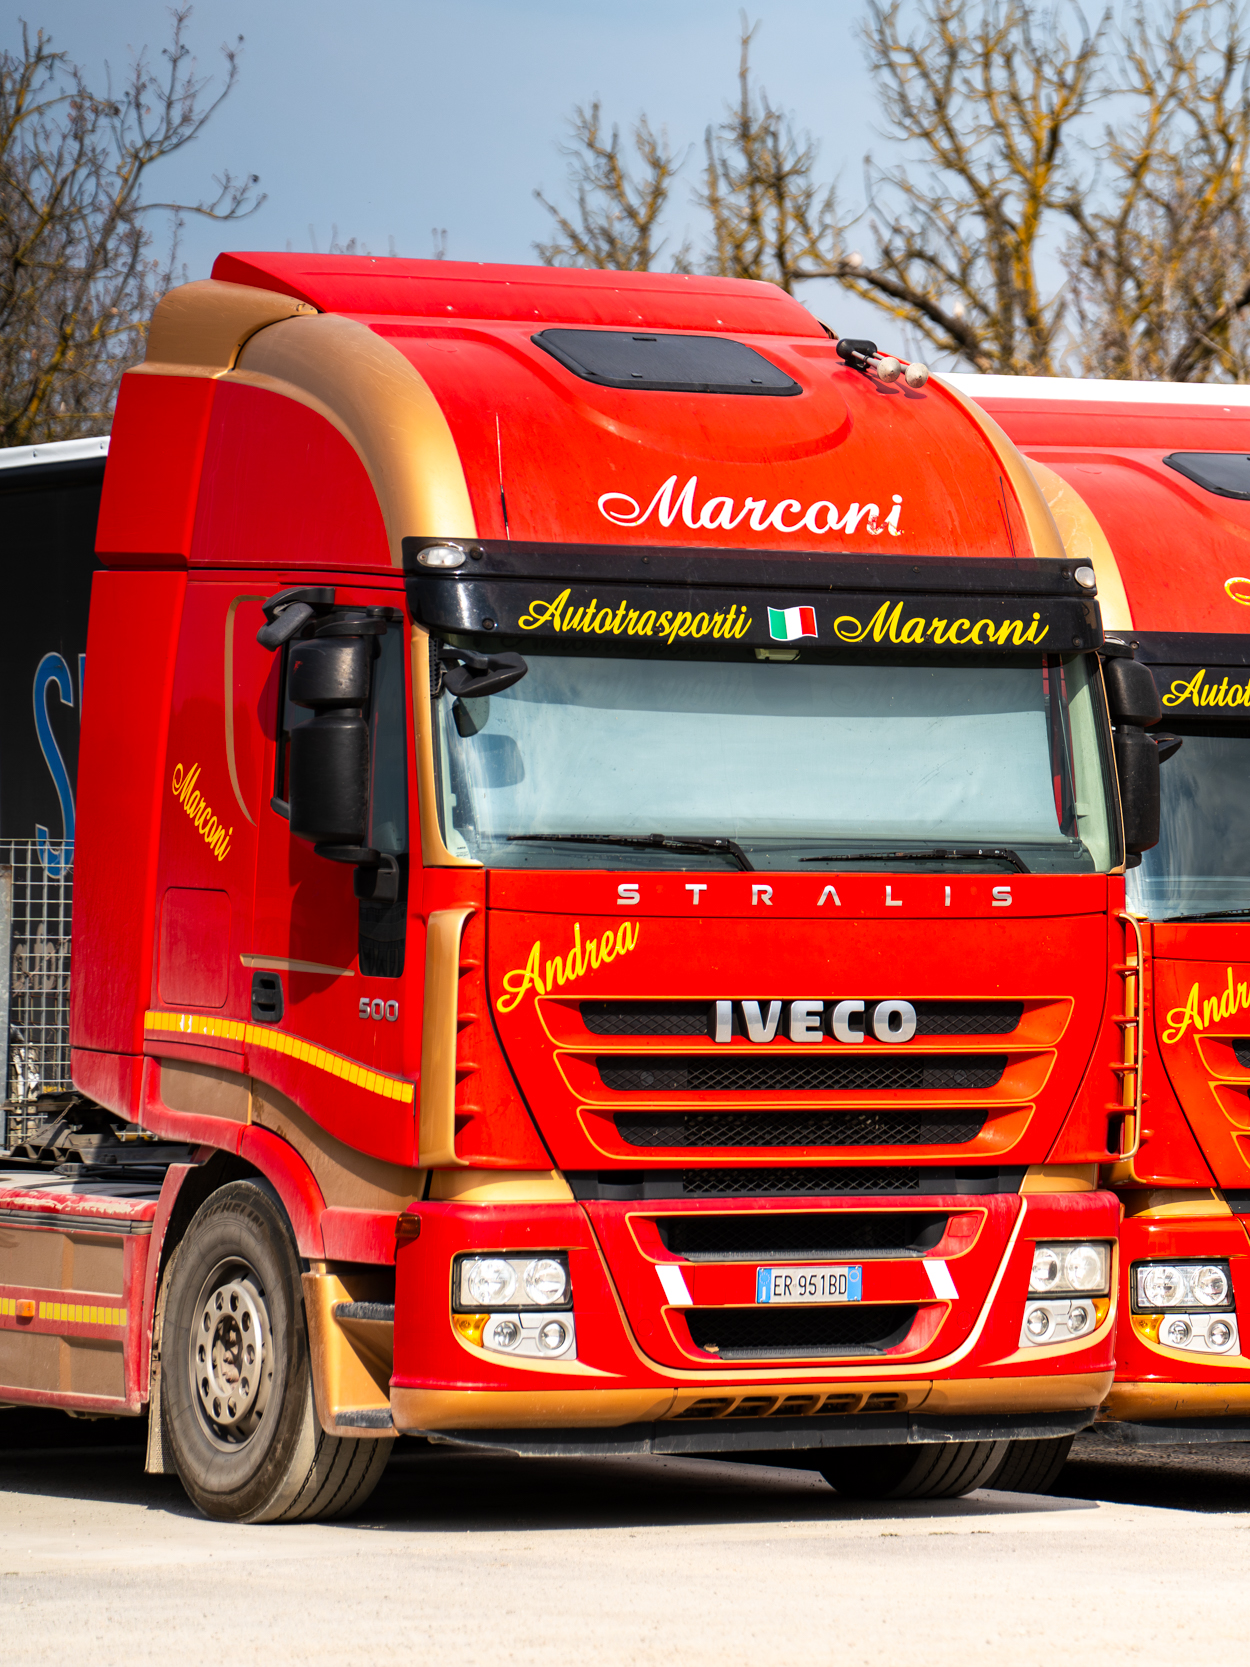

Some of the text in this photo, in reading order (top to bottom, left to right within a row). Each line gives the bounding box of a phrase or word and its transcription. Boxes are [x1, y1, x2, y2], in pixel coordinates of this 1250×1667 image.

[597, 474, 904, 537] Marconi
[517, 588, 1050, 646] Autotrasporti Marconi
[33, 651, 87, 880] S
[171, 762, 234, 862] Marconi
[616, 883, 1013, 907] STRALIS
[496, 921, 640, 1014] Andrea
[358, 996, 400, 1022] 500
[712, 999, 918, 1044] IVECO
[773, 1273, 848, 1296] ER 951BD
